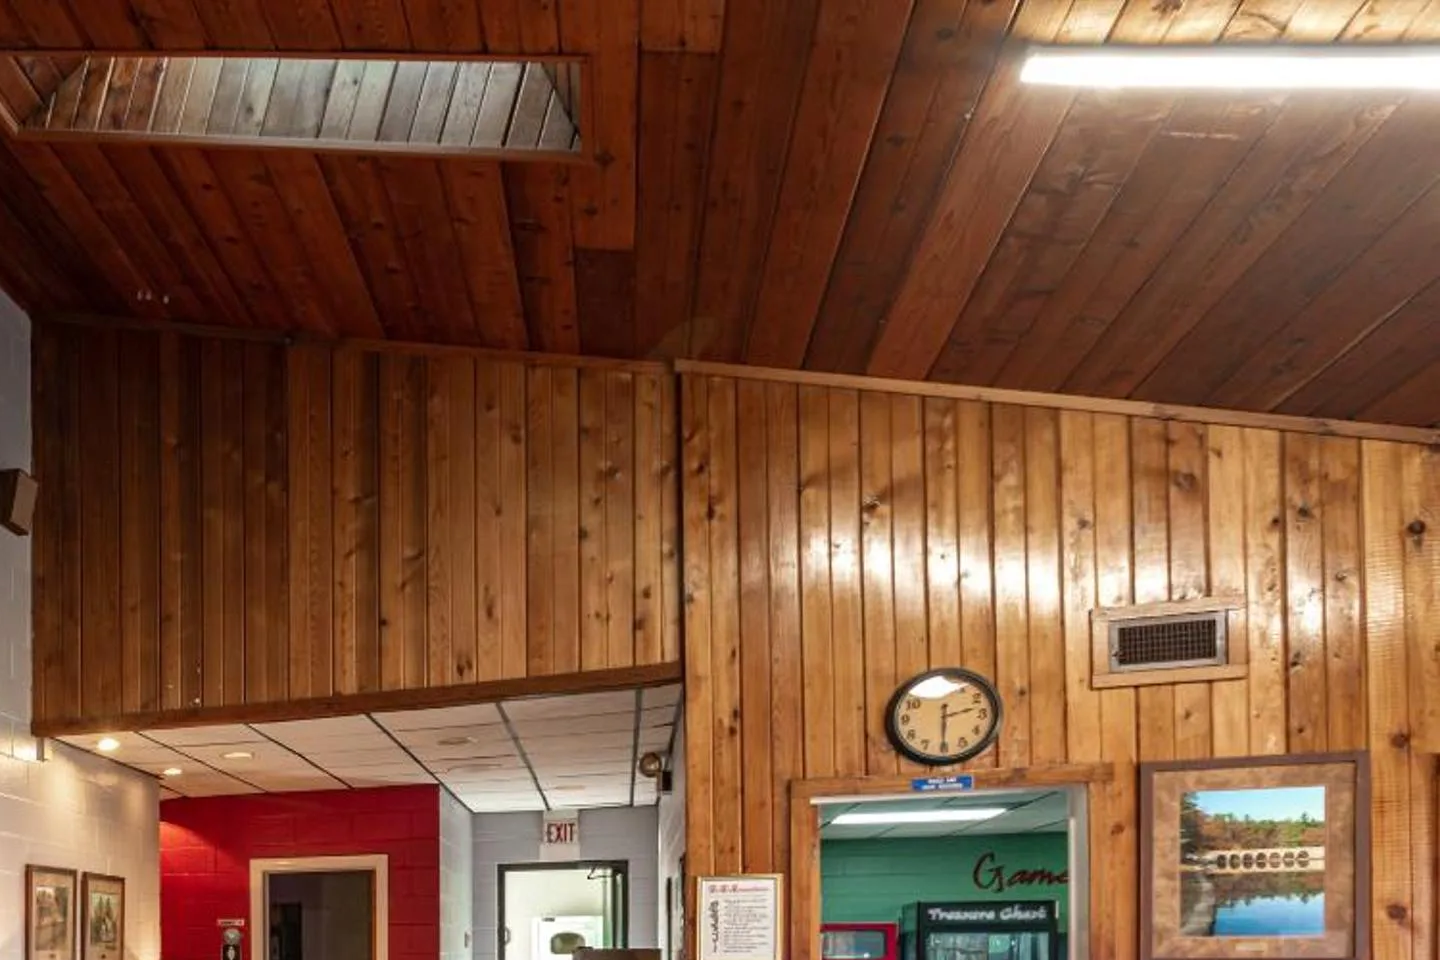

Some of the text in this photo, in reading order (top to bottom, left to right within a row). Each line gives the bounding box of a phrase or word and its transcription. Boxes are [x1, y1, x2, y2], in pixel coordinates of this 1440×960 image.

[906, 698, 921, 710] 10
[921, 739, 930, 750] 7
[546, 822, 576, 844] EXIT
[972, 851, 1069, 893] Game
[927, 904, 1047, 921] Treasure Chest
